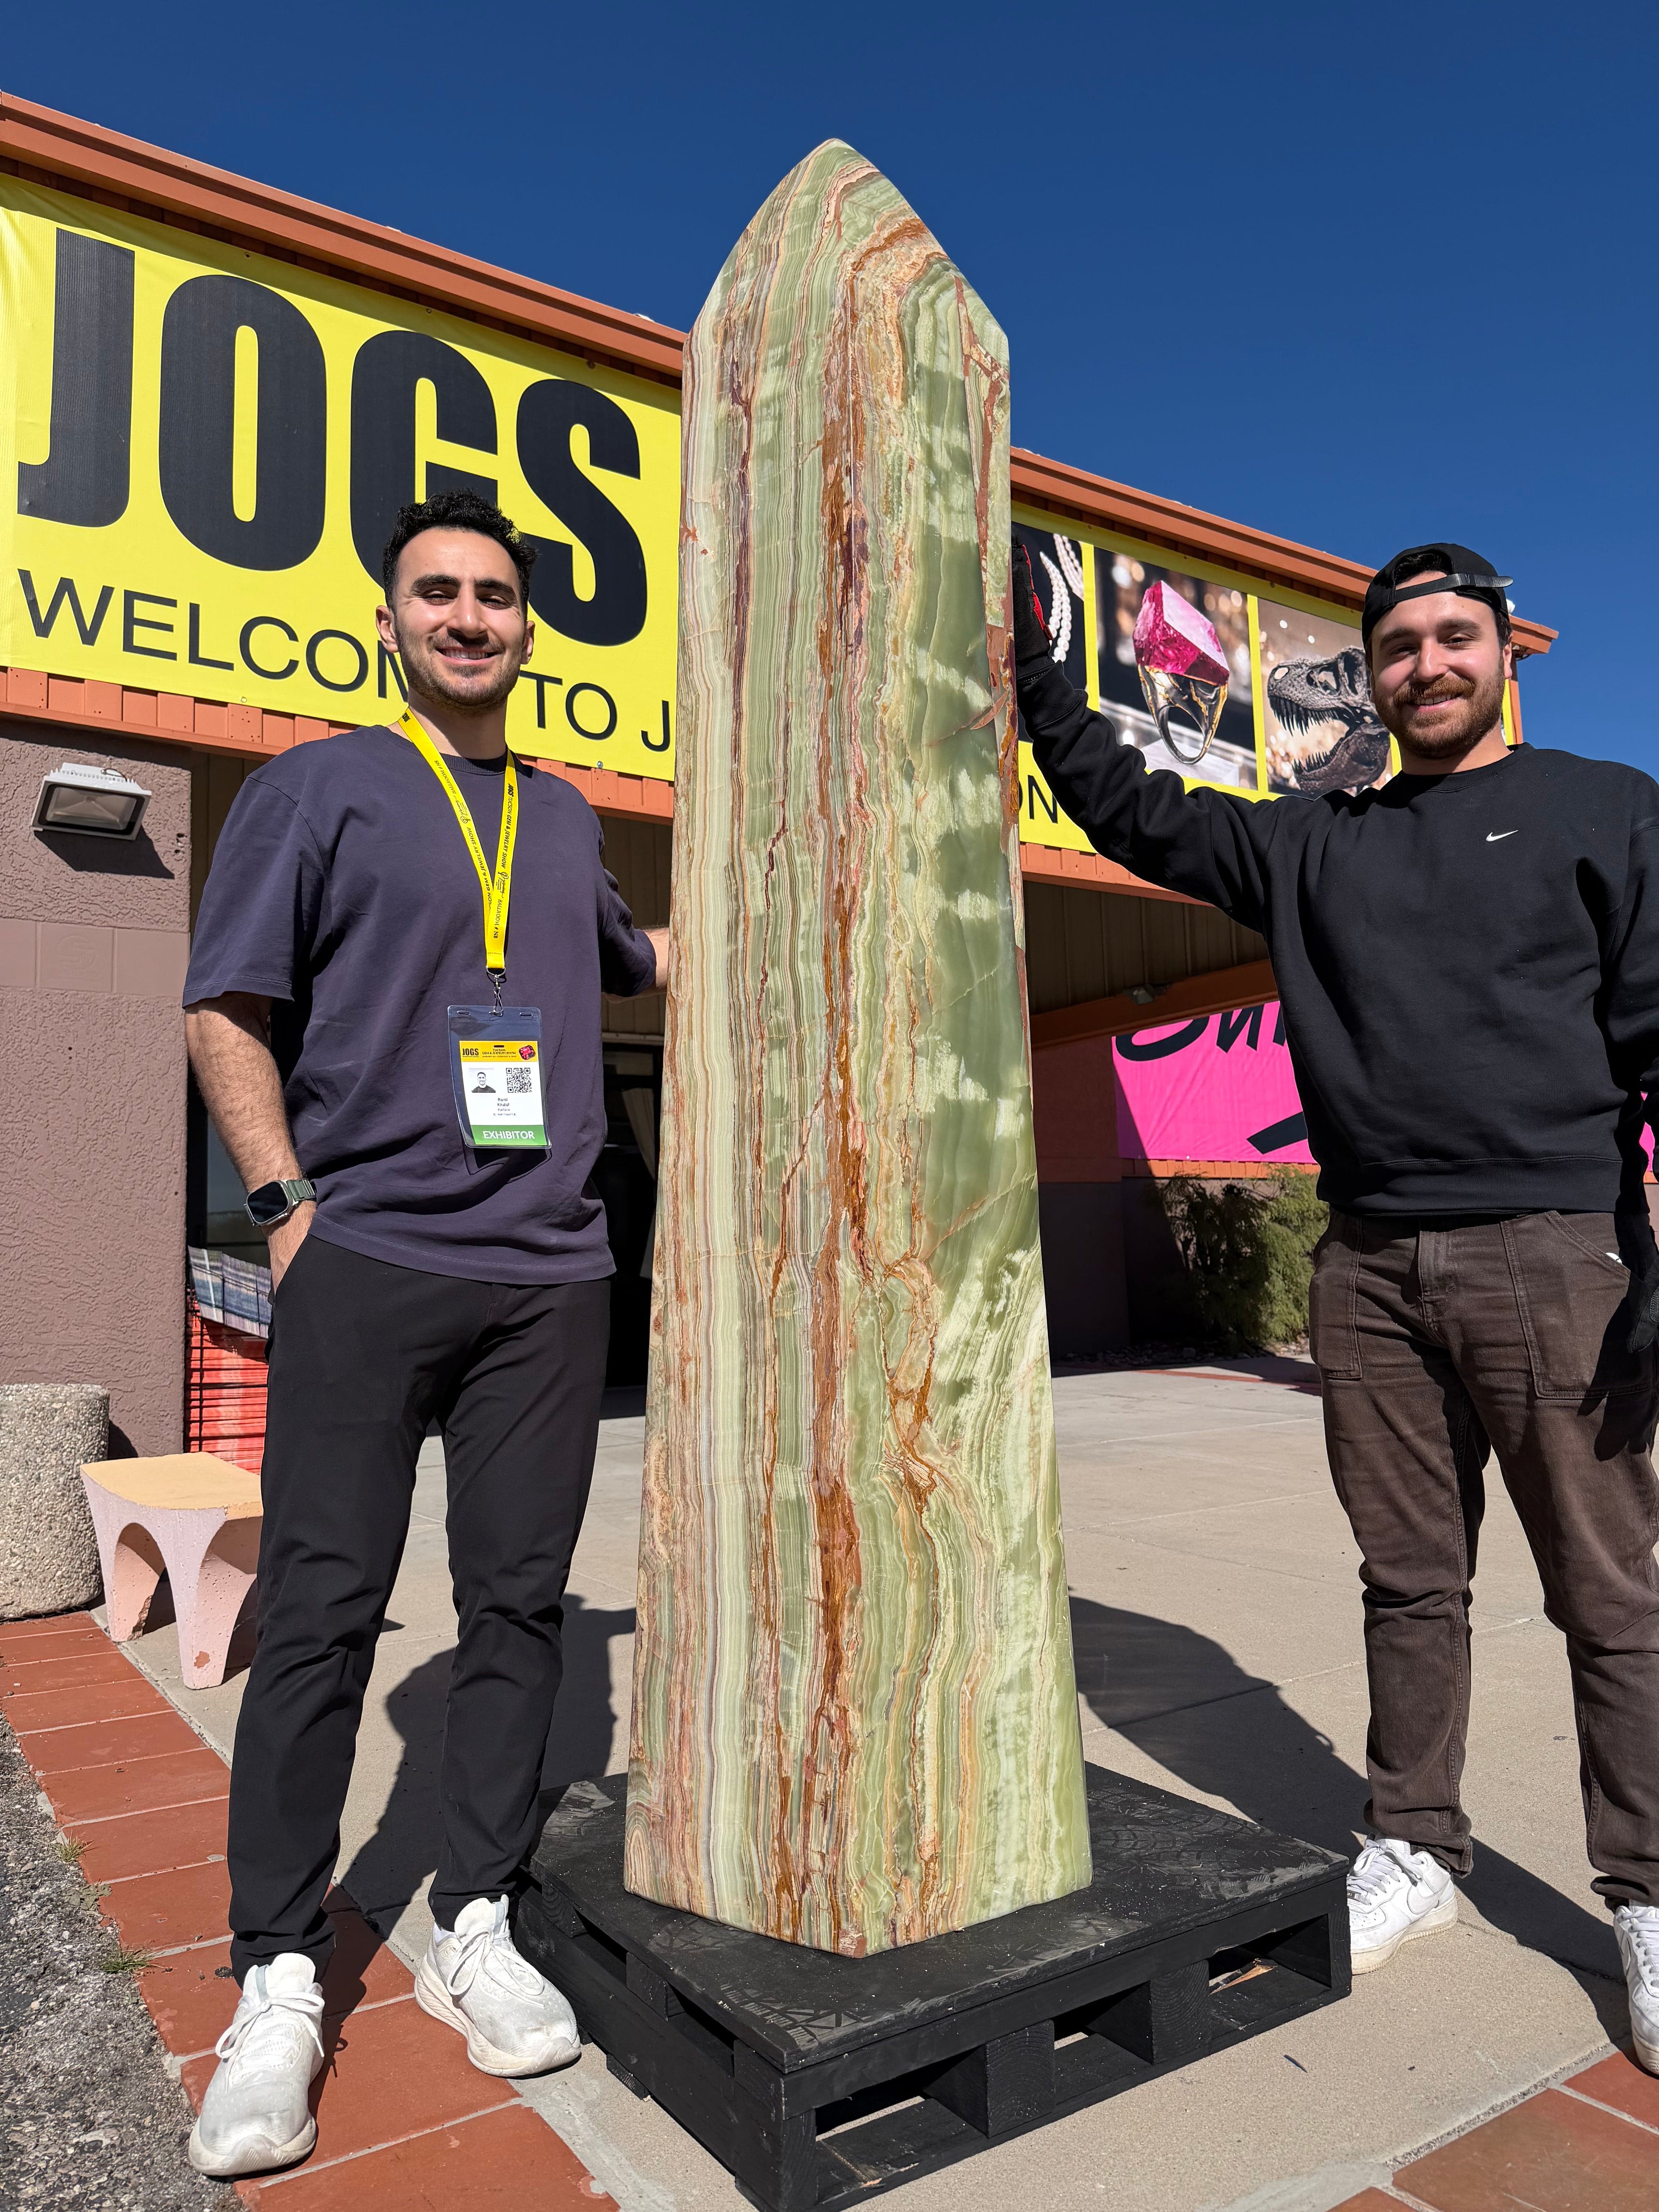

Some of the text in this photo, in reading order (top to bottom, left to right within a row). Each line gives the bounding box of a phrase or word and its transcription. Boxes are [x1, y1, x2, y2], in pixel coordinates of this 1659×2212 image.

[18, 227, 647, 646] JOGS
[18, 568, 408, 702] WELCOM
[519, 670, 617, 740] TO
[440, 770, 456, 794] BALLROOM
[467, 827, 476, 845] SHOW
[474, 845, 486, 871] JEWELRY
[483, 1131, 535, 1139] EXHIBITOR
